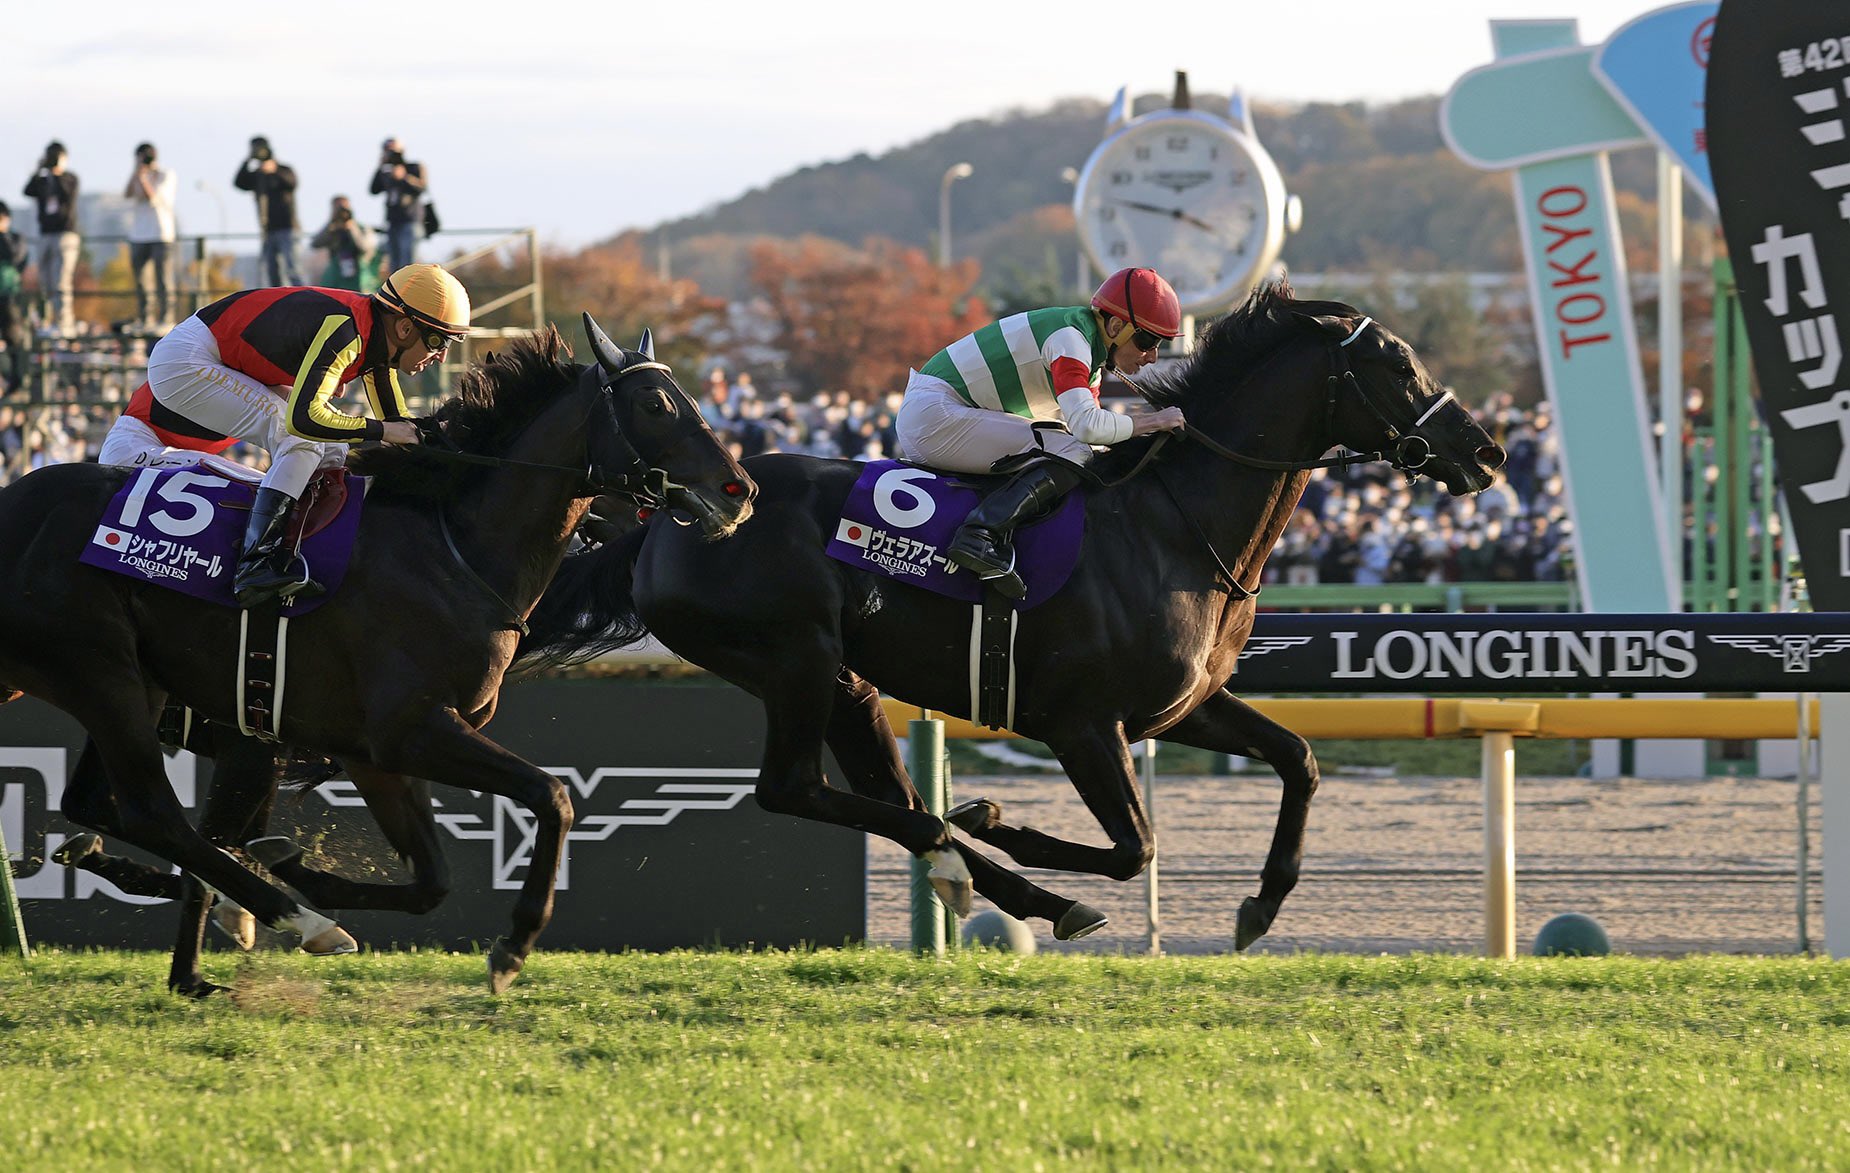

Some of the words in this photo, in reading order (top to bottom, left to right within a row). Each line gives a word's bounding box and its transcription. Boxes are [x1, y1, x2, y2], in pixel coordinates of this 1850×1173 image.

[1537, 185, 1612, 361] TOKYO
[1750, 224, 1850, 504] カップ
[119, 467, 230, 537] 15
[873, 468, 937, 529] 6
[118, 553, 189, 581] LONGINES
[129, 534, 223, 578] シャフリヤール
[862, 548, 928, 577] LONGINES
[871, 529, 960, 575] ヴェラアズール
[1330, 629, 1698, 680] LONGINES
